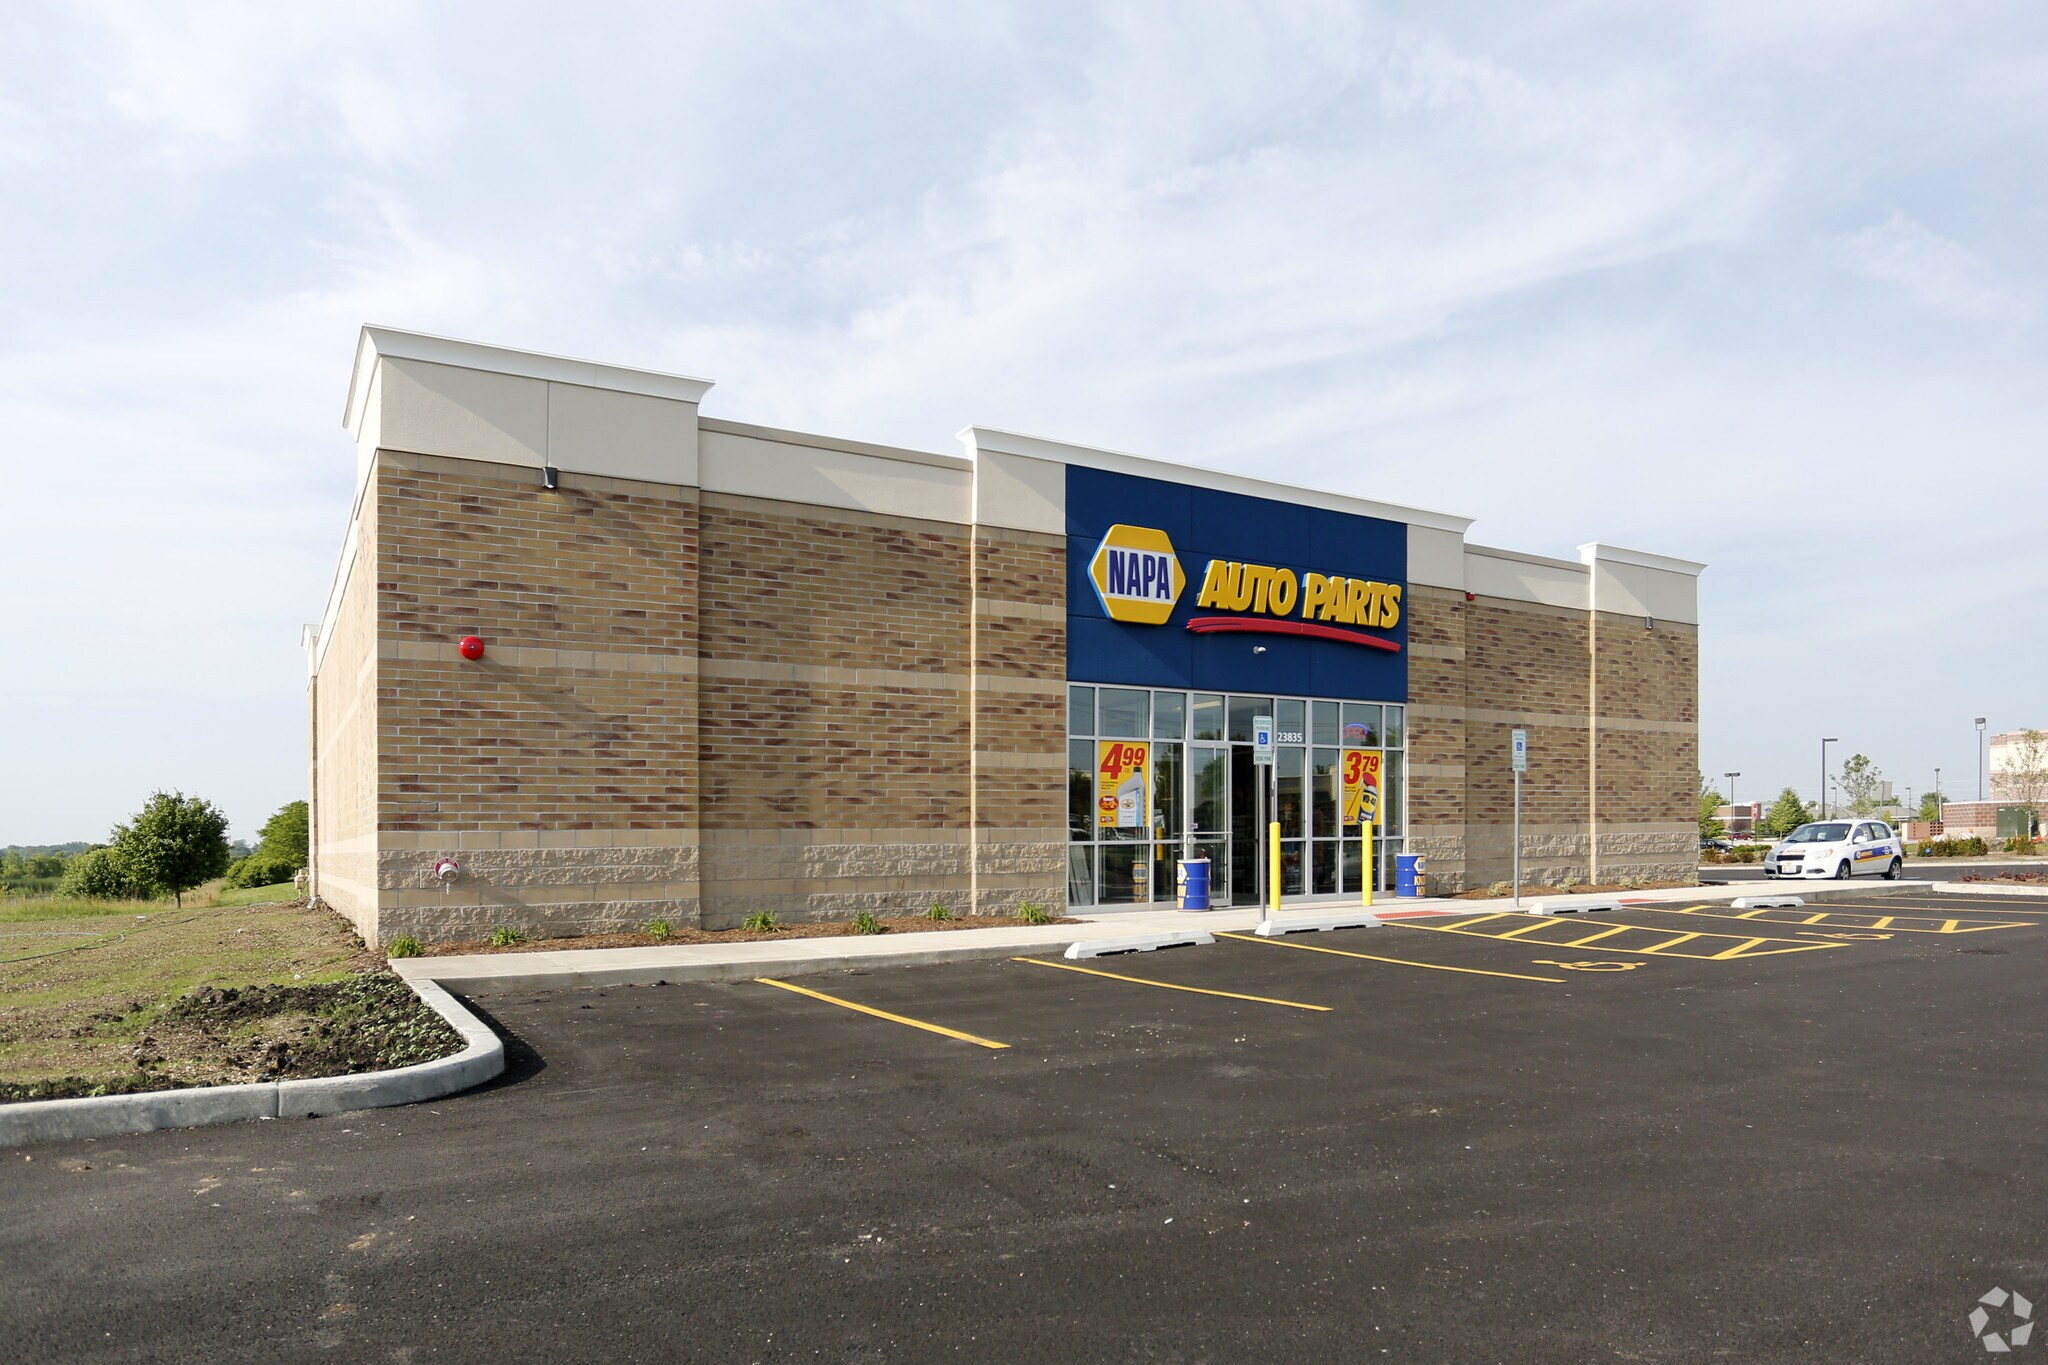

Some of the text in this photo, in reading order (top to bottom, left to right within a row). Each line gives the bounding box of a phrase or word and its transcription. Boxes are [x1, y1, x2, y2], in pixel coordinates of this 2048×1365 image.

[1109, 549, 1170, 600] NAPA
[1196, 559, 1402, 629] AUTO PARTS
[1277, 732, 1303, 742] 23835
